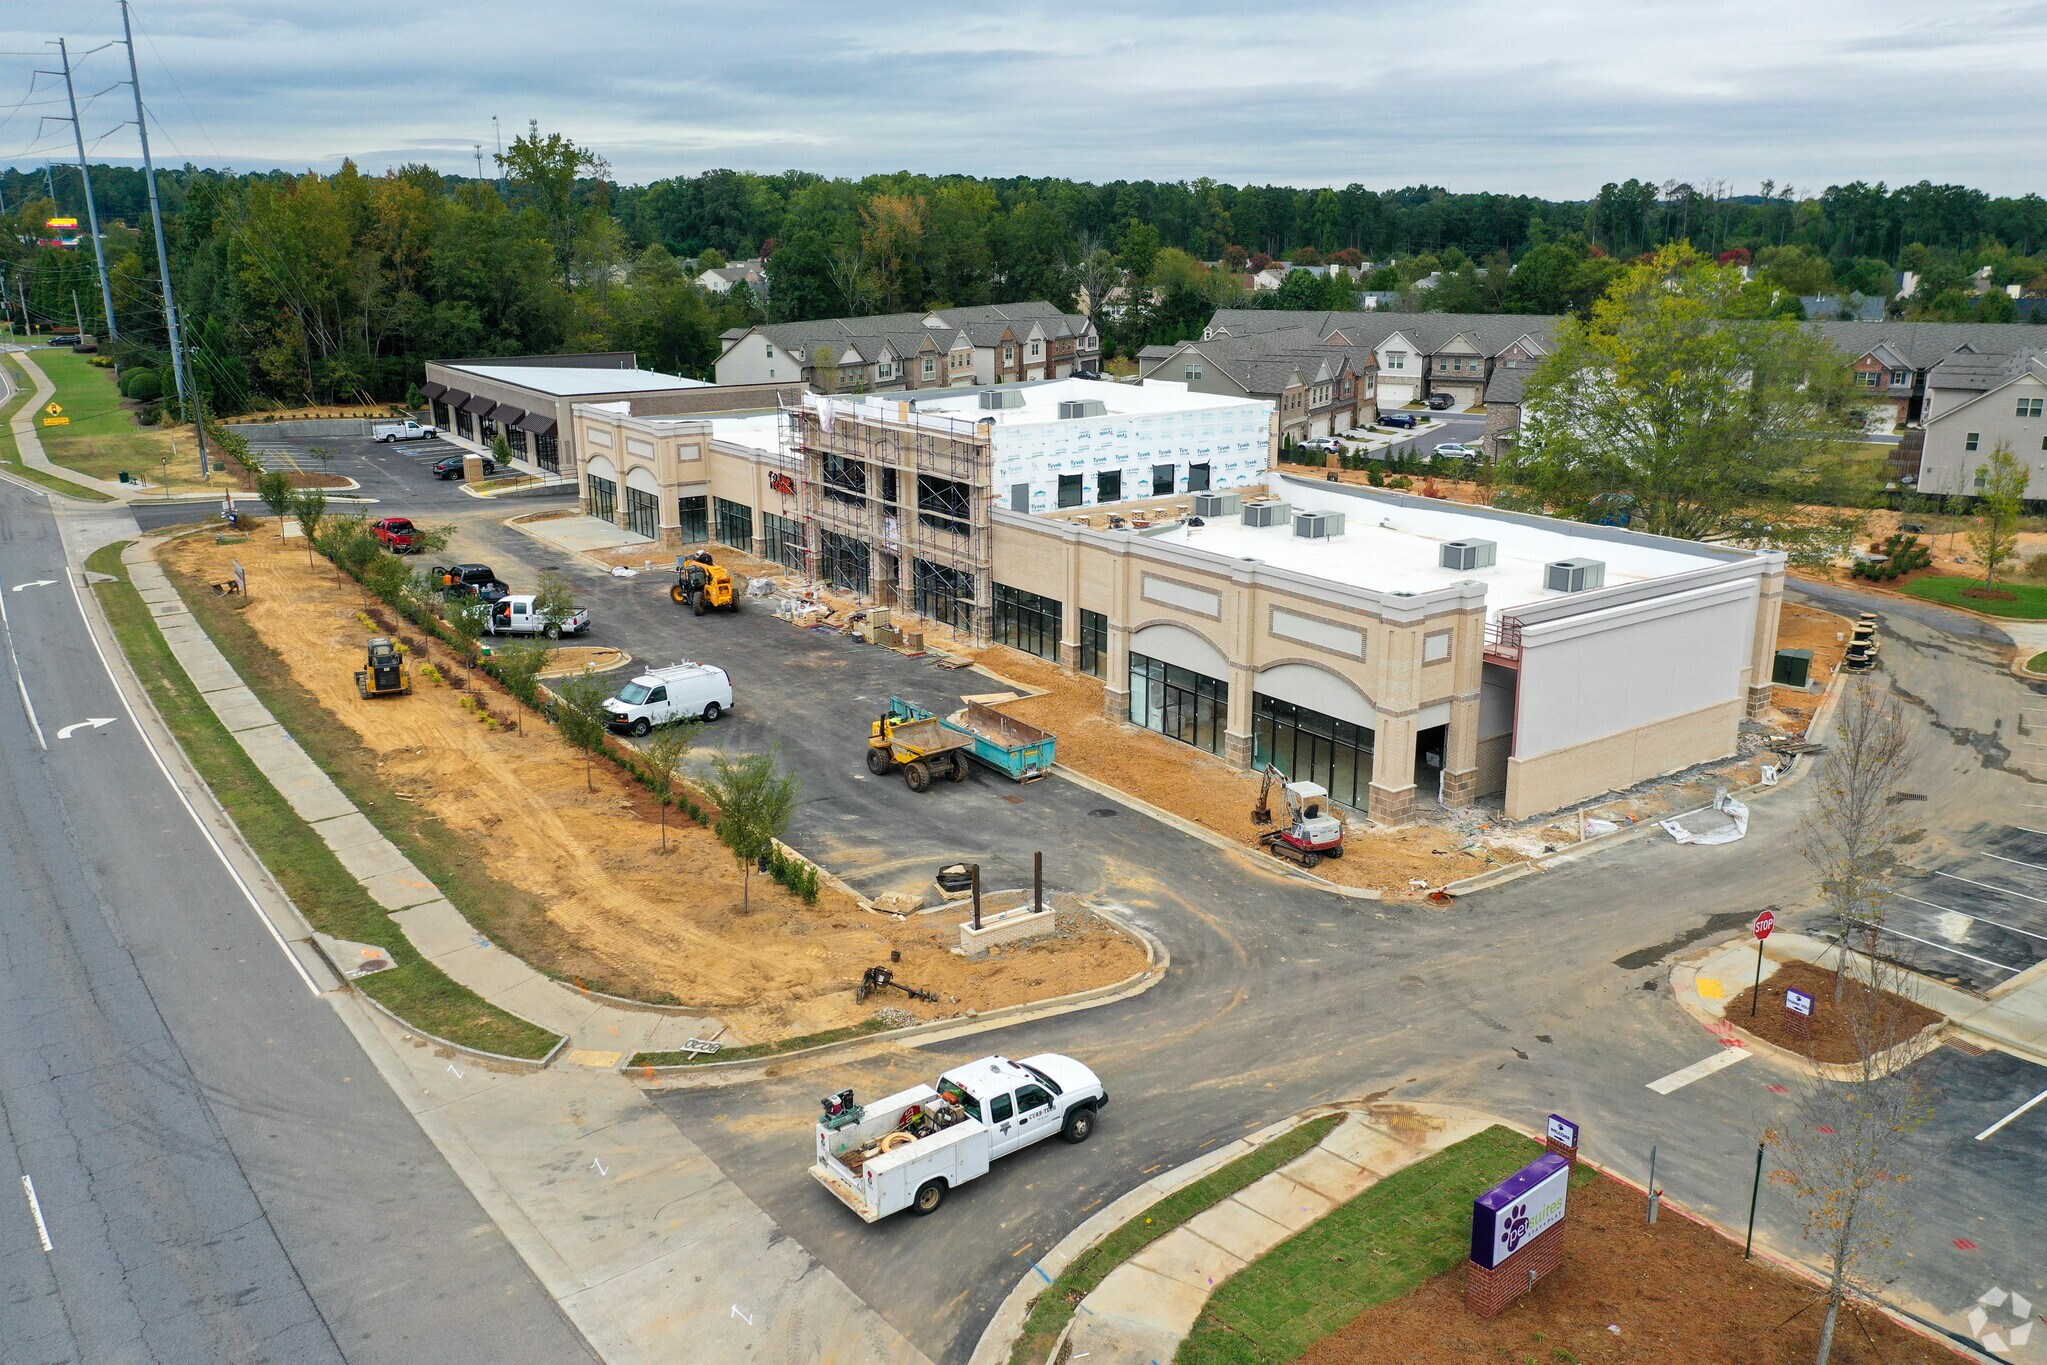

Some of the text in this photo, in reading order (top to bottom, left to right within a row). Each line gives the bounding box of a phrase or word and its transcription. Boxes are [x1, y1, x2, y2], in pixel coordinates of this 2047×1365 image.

[1755, 918, 1774, 933] STOP
[685, 1040, 719, 1052] 8020
[1550, 1127, 1570, 1140] WELCOME
